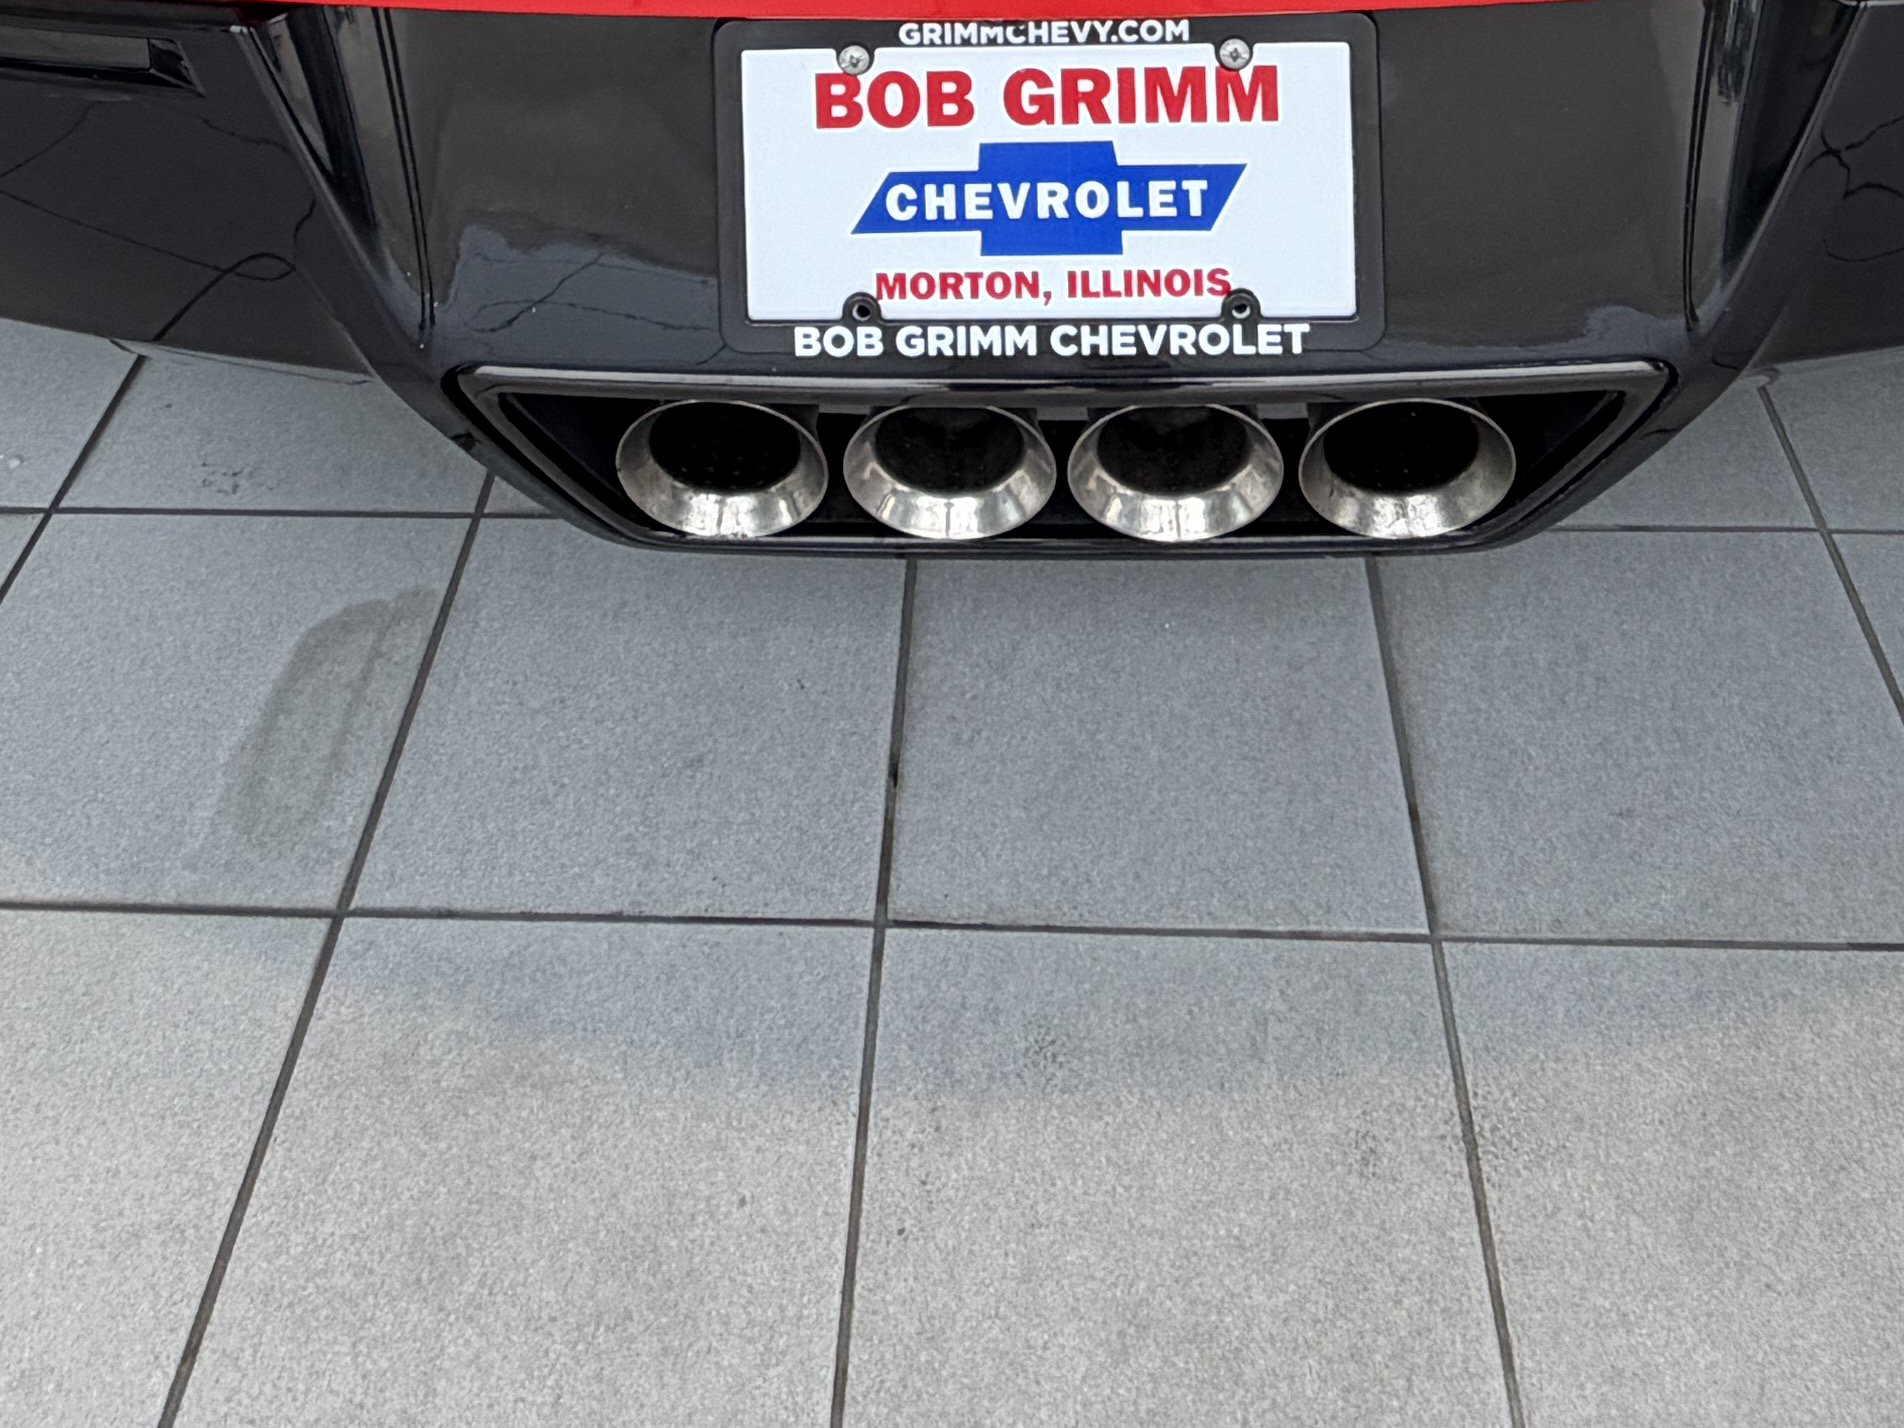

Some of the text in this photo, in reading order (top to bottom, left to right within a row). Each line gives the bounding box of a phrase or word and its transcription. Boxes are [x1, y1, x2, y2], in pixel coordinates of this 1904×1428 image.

[898, 19, 1191, 46] GRIMMCHEVY.COM
[815, 64, 1279, 131] BOB GRIMM
[886, 177, 1209, 222] CHEVROLET
[875, 266, 1232, 307] MORTON, ILLINOIS
[794, 322, 1312, 359] BOB GRIMM CHEVROLET
